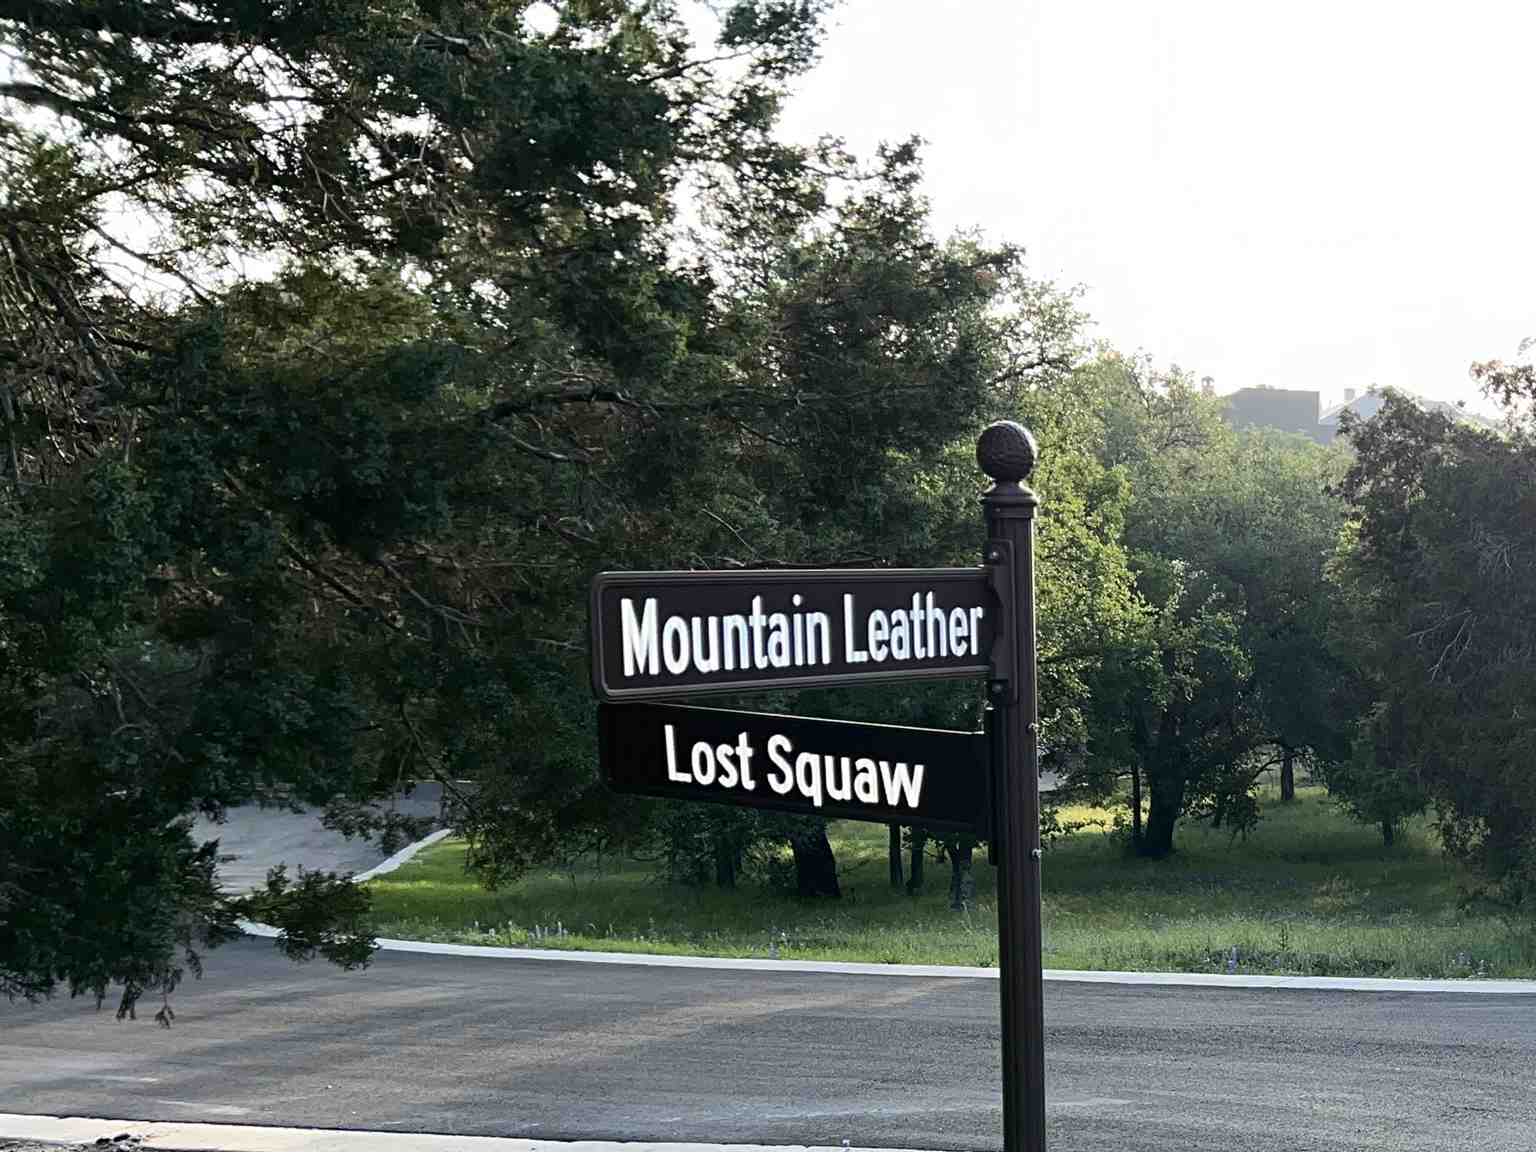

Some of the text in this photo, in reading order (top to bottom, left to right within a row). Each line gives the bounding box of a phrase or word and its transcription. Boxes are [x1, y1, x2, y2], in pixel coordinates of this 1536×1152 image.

[620, 591, 984, 677] Mountain Leather
[664, 724, 925, 808] Lost Squaw
